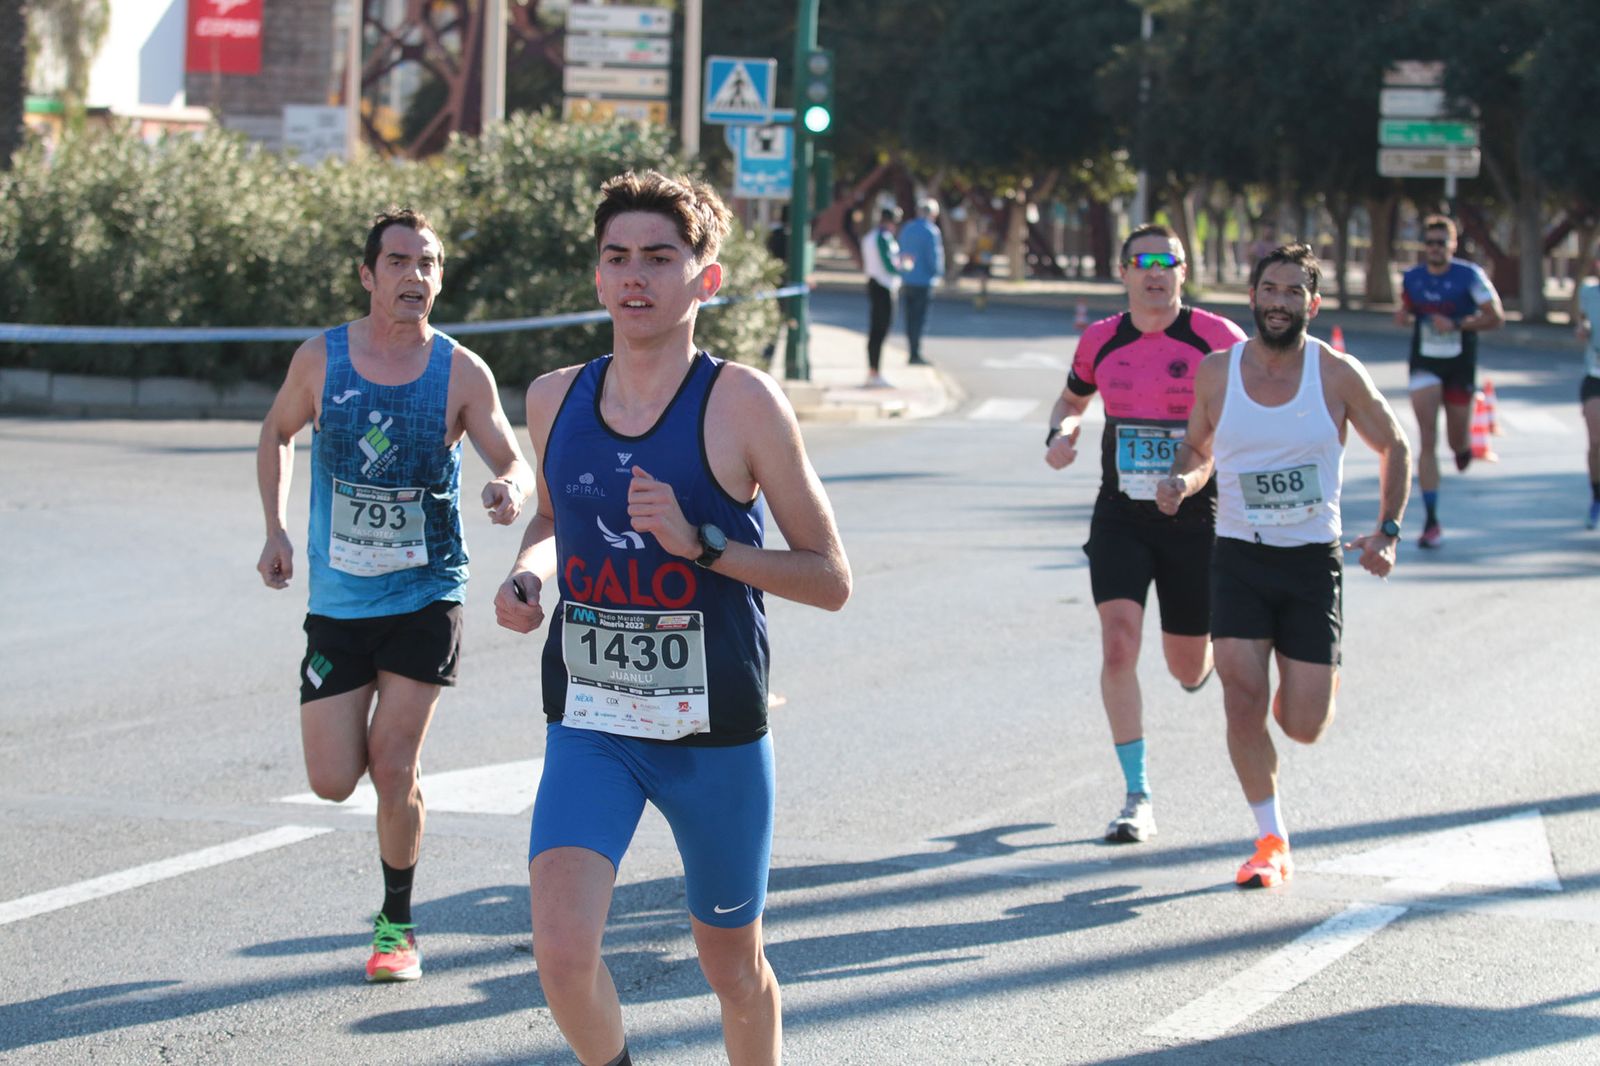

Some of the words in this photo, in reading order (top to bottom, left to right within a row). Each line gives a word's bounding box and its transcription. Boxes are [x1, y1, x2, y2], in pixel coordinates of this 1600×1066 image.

[566, 484, 606, 497] SPIRAL
[1256, 470, 1305, 494] 568
[350, 500, 407, 530] 793
[564, 555, 697, 609] GALO
[598, 612, 616, 621] Medio
[617, 614, 645, 623] Maratón
[599, 618, 625, 629] Almería
[625, 621, 645, 630] 2022
[580, 628, 689, 672] 1430
[610, 671, 653, 683] JUANLU
